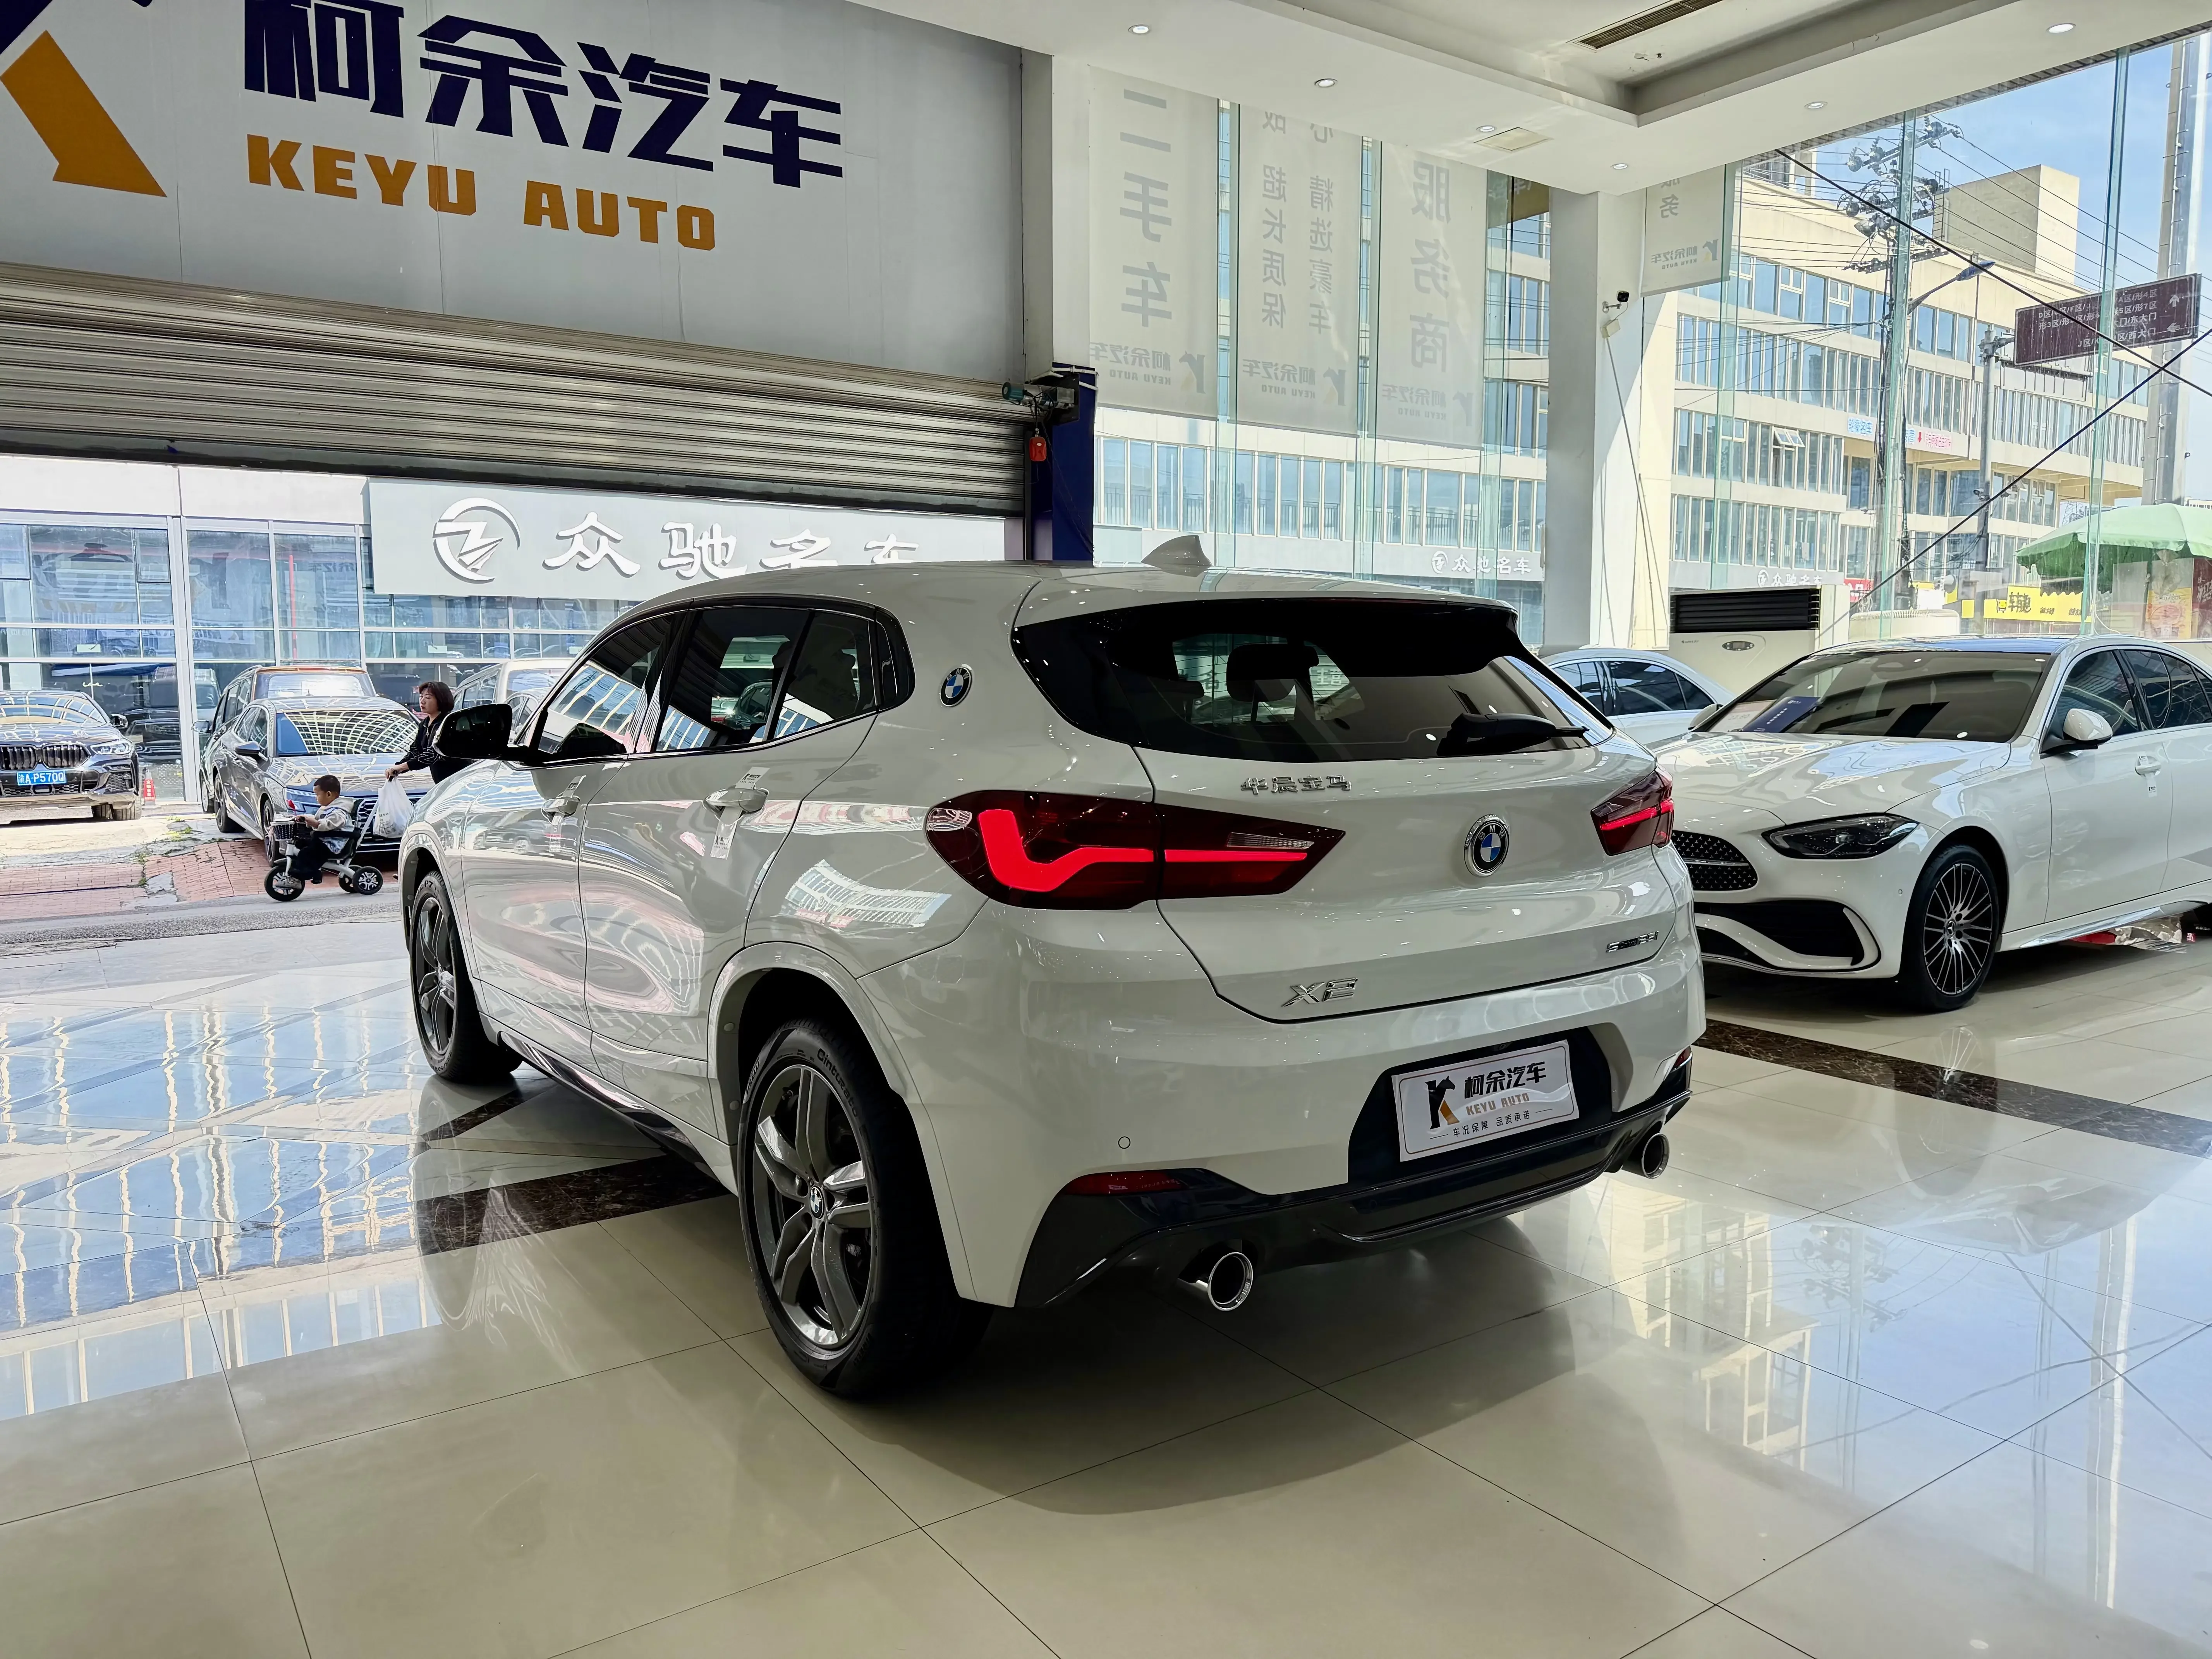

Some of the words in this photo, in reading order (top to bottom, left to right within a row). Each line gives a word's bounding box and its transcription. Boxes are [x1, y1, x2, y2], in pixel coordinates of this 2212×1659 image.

[244, 0, 843, 188] 柯余汽车
[248, 136, 476, 215] KEYU
[524, 181, 714, 250] AUTO
[946, 668, 969, 681] BMW
[1240, 775, 1352, 795] 华晨宝马
[1478, 825, 1504, 841] BMW
[1281, 977, 1358, 1008] X2
[1464, 1061, 1546, 1099] 柯余汽车
[1466, 1100, 1496, 1116] KEYU
[1501, 1092, 1530, 1108] AUTO
[1453, 1121, 1488, 1137] 车况保障
[1496, 1110, 1530, 1127] 品质承诺
